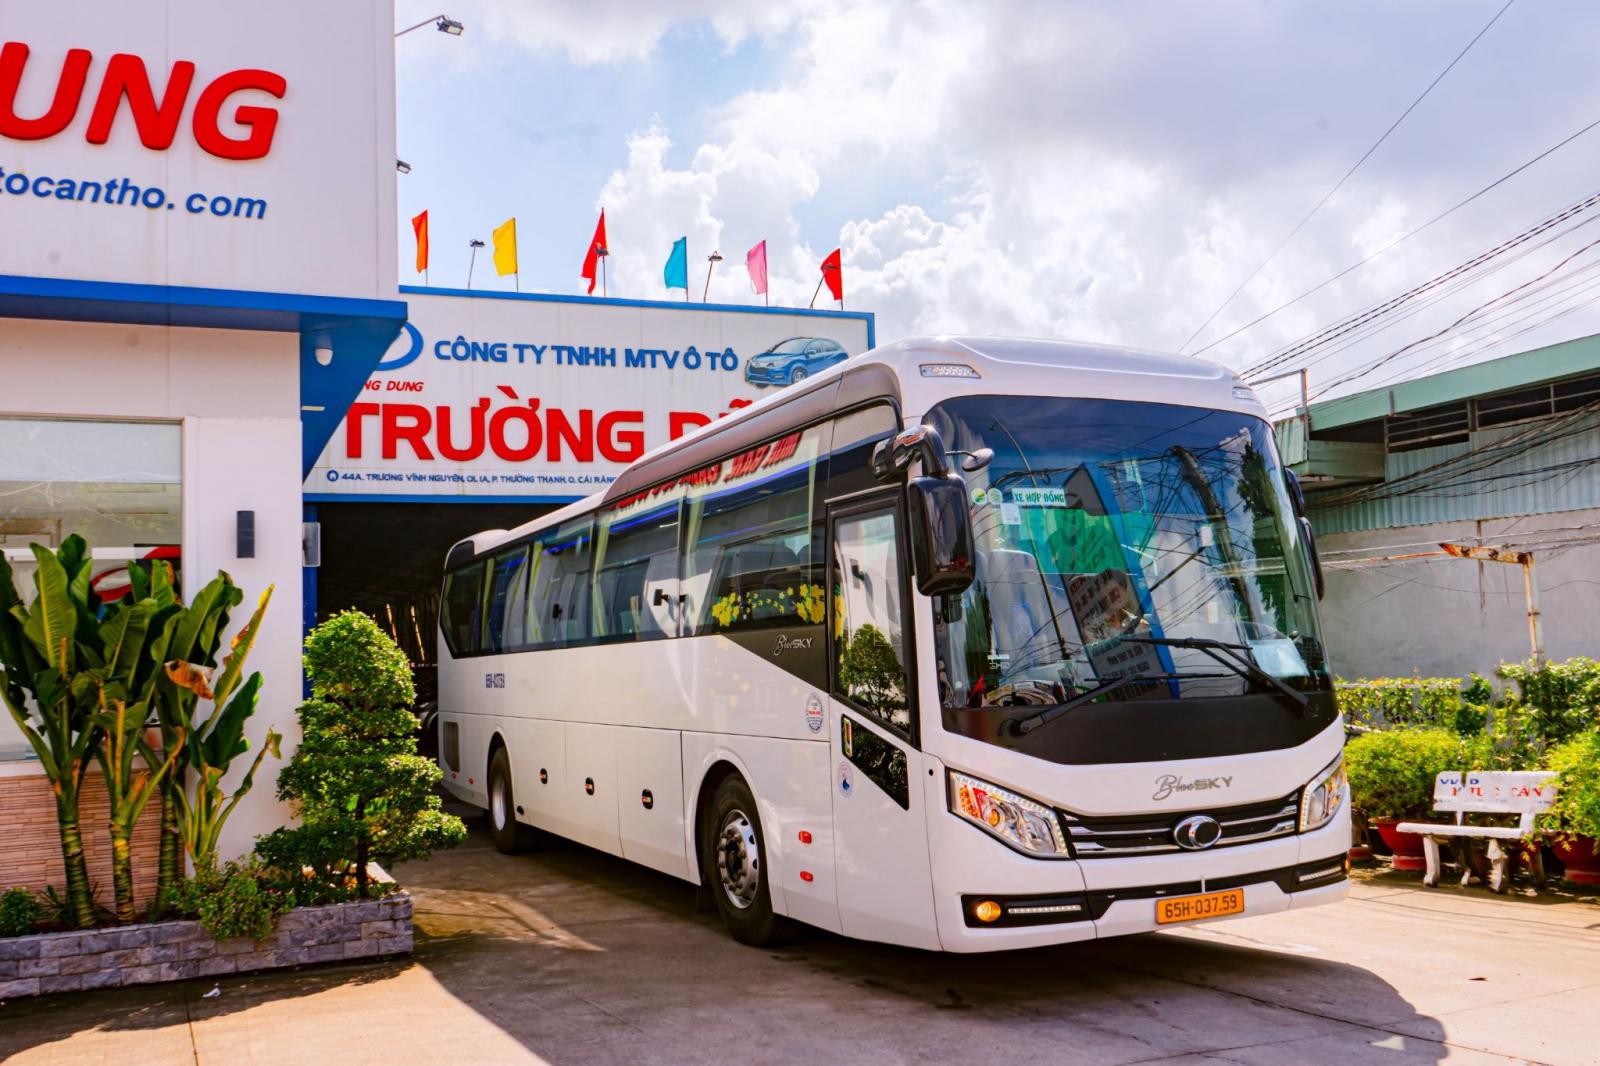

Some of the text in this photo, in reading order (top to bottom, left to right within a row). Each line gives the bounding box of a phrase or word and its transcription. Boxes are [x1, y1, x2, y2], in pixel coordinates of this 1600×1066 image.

[0, 41, 287, 162] UNG
[433, 336, 739, 372] CÔNG TY TNHH MTV Ô TÔ
[386, 380, 424, 392] DUNG
[346, 384, 645, 464] TRƯỜNG
[1165, 894, 1237, 918] 65H-037.59
